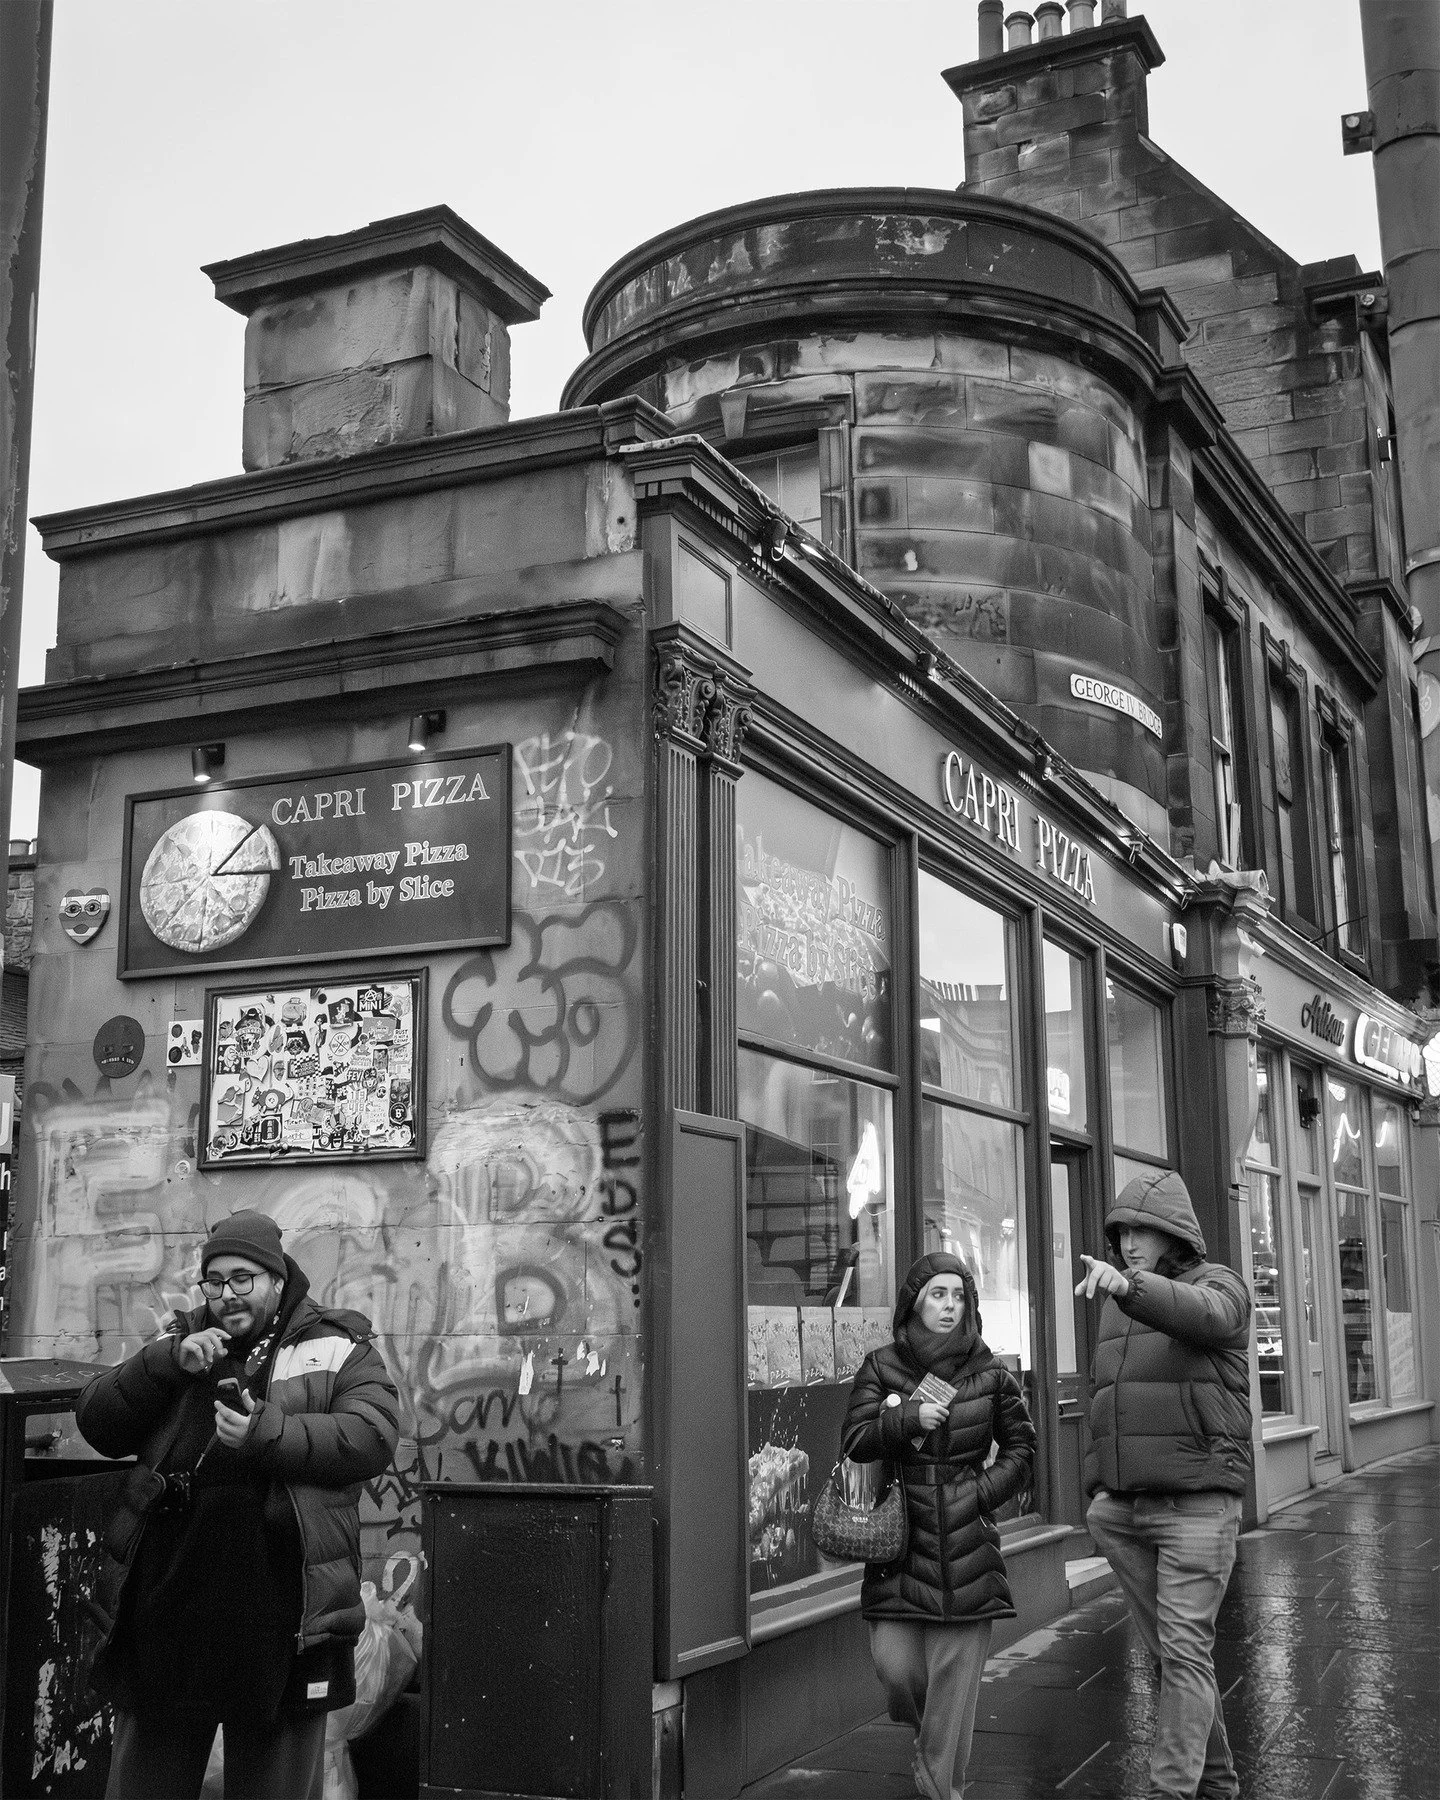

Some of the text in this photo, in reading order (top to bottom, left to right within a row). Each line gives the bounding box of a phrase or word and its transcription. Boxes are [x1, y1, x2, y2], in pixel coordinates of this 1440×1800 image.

[1074, 677, 1125, 710] GEORGE
[1137, 700, 1162, 737] BRIDGE
[271, 772, 491, 826] CAPRI PIZZA
[945, 750, 1098, 906] CAPRI PIZZA
[289, 840, 469, 880] Takeaway Pizza
[300, 874, 455, 912] Pizza by Slice
[836, 874, 886, 941] Pizza
[738, 899, 877, 1002] Pizza by Slice
[359, 1000, 382, 1011] MINI
[1301, 994, 1345, 1047] Artisan
